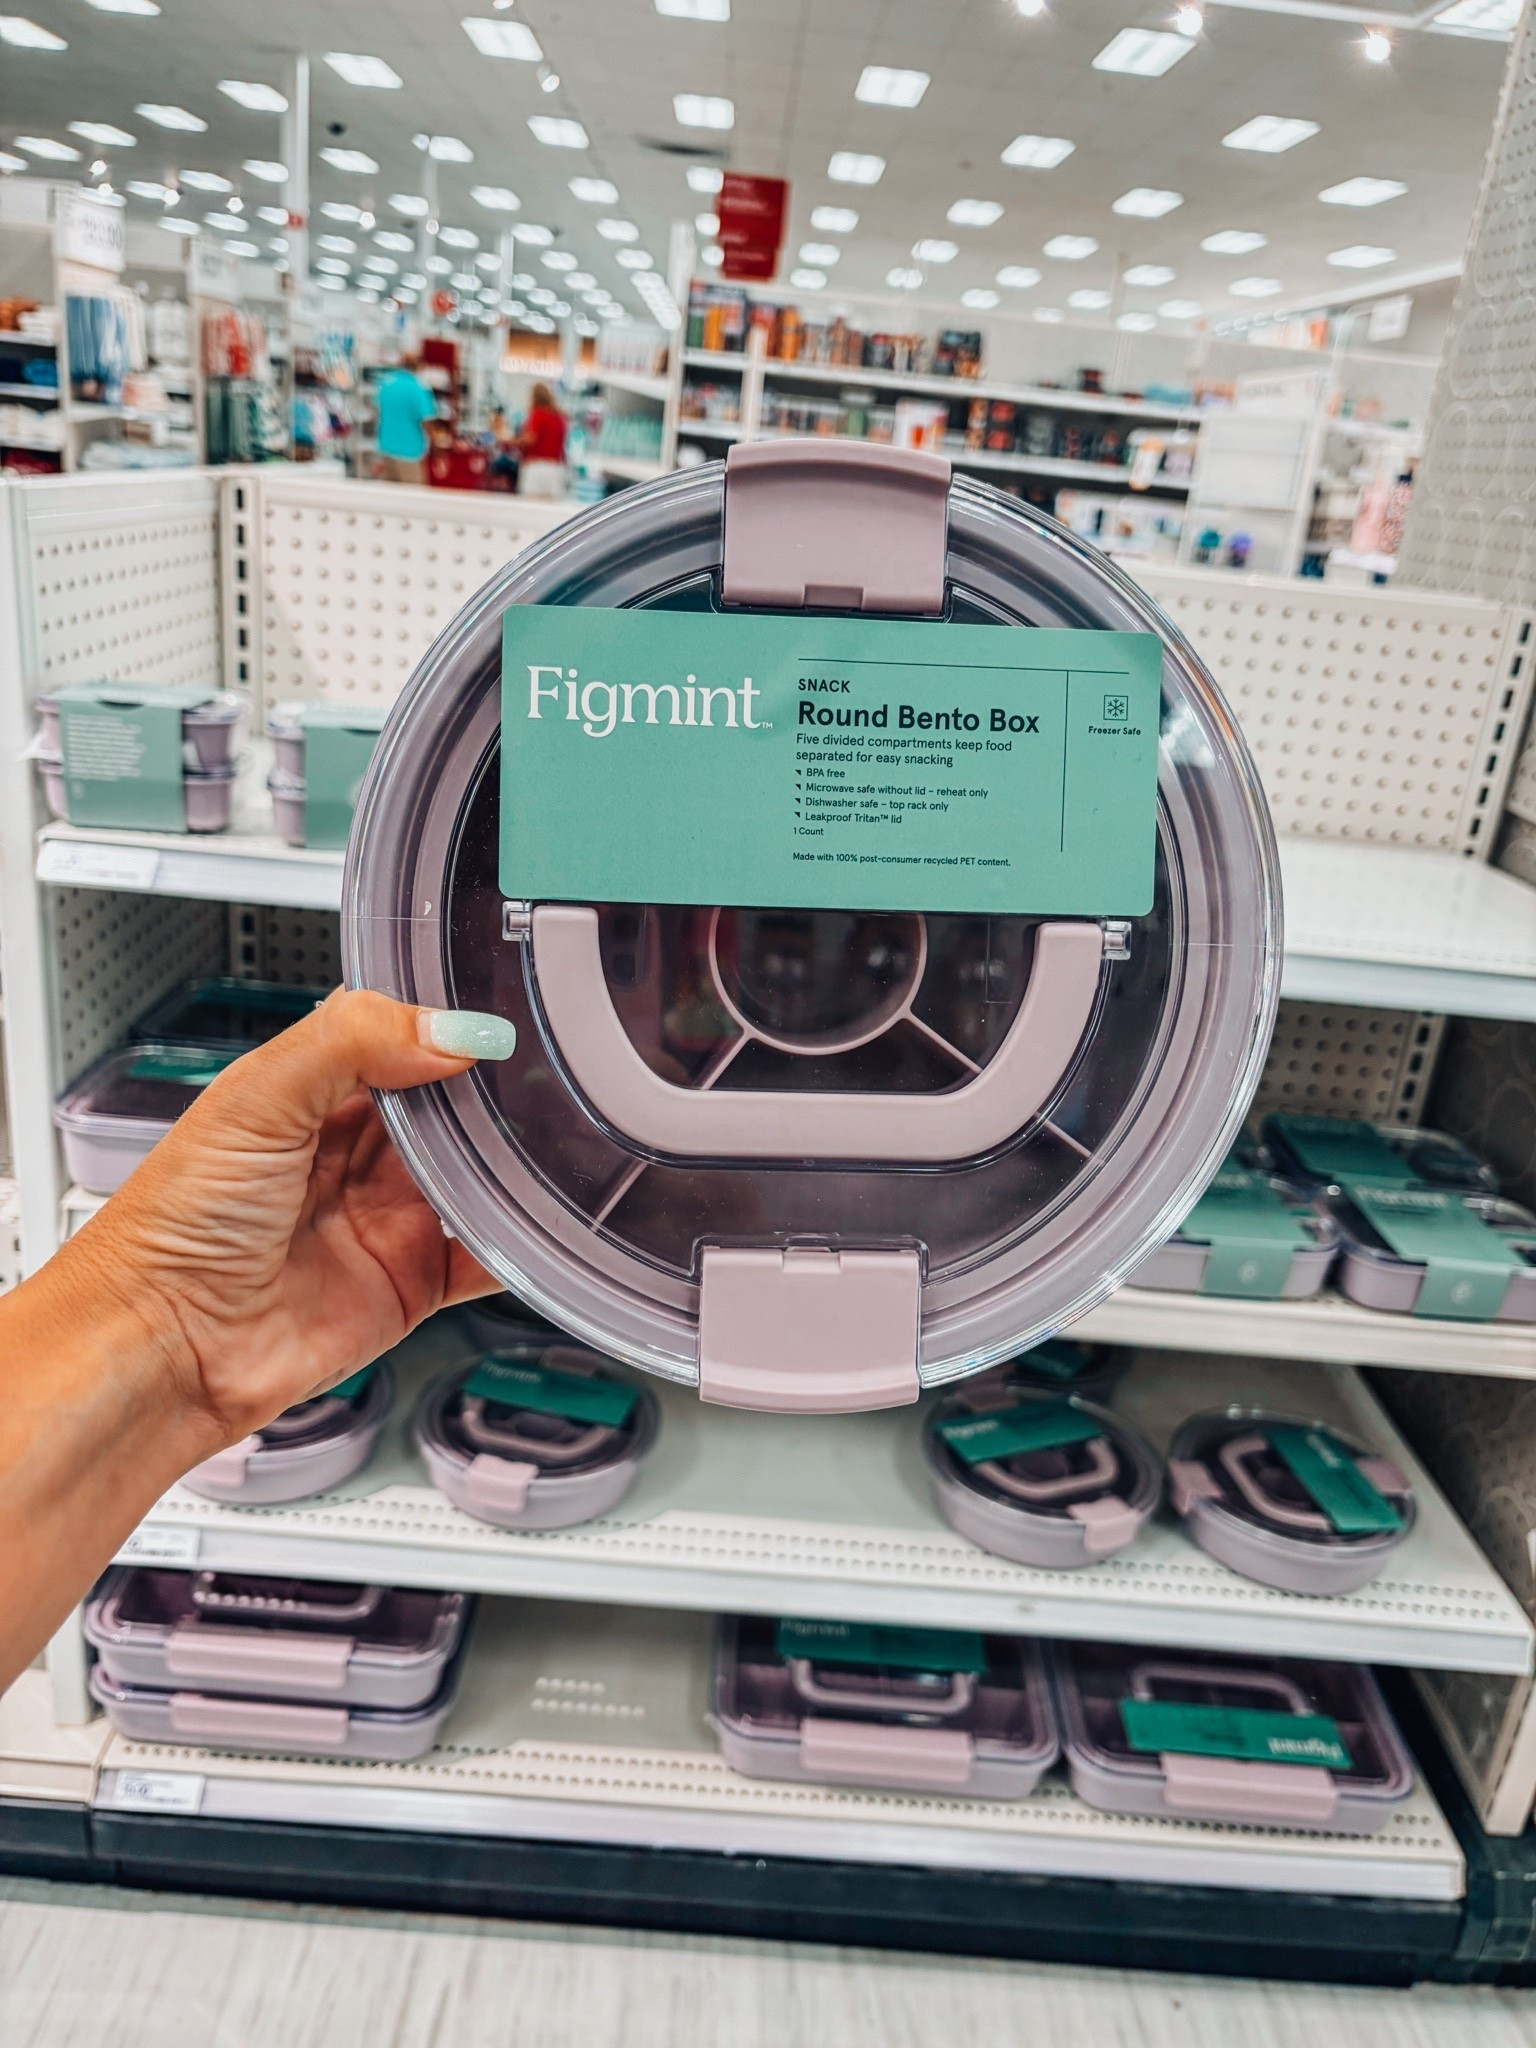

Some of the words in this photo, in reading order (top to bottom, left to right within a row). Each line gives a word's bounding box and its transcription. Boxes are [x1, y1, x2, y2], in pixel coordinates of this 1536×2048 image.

[798, 678, 850, 693] SNACK
[798, 700, 888, 728] Round
[898, 705, 980, 731] Bento
[990, 708, 1040, 734] Box
[1088, 725, 1121, 735] Freezer
[1122, 727, 1141, 736] Safe
[796, 733, 819, 745] Five
[822, 734, 864, 746] divided
[867, 737, 952, 750] compartments
[955, 739, 983, 753] keep
[985, 740, 1012, 751] food
[796, 751, 853, 763] separated
[856, 751, 873, 763] for
[876, 754, 902, 766] easy
[904, 754, 953, 768] snacking
[806, 767, 825, 777] BPA
[826, 768, 846, 778] free
[806, 782, 855, 793] Microwave
[857, 784, 875, 794] safe
[877, 785, 913, 795] without
[915, 786, 926, 795] lid
[936, 787, 967, 797] reheat
[968, 788, 989, 799] only
[805, 797, 858, 808] Dishwasher
[860, 799, 879, 808] safe
[889, 800, 905, 811] top
[907, 801, 927, 810] rack
[929, 801, 949, 812] only
[805, 812, 852, 823] Leakproof
[891, 814, 902, 824] lid
[793, 827, 797, 835] 1
[798, 827, 824, 836] Count
[793, 852, 815, 861] Made
[816, 853, 834, 861] with
[836, 853, 858, 862] 100%
[859, 855, 922, 864] post-consumer
[923, 857, 958, 866] recycled
[960, 857, 976, 865] PET
[977, 858, 1011, 866] content.
